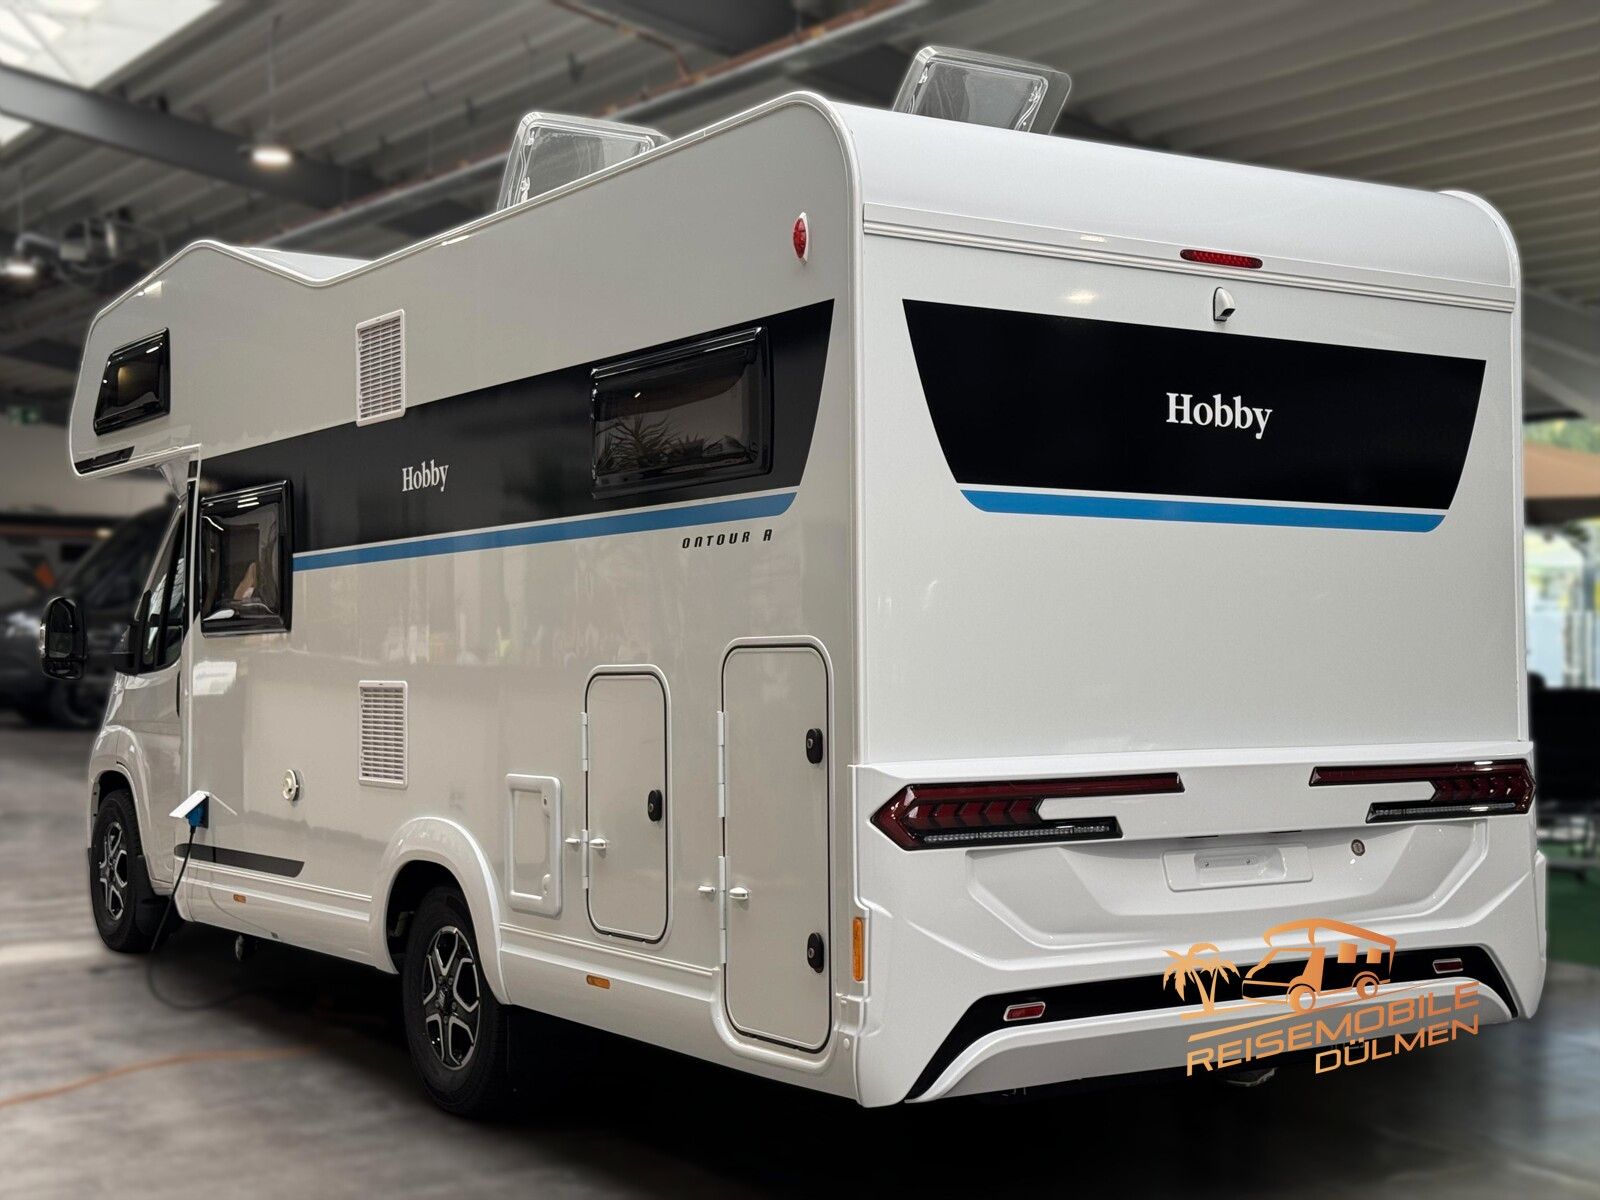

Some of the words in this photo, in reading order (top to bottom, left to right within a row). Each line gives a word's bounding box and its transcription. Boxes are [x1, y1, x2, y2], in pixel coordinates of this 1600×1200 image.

[1166, 392, 1273, 440] Hobby
[401, 459, 449, 492] Hobby
[763, 529, 773, 542] A
